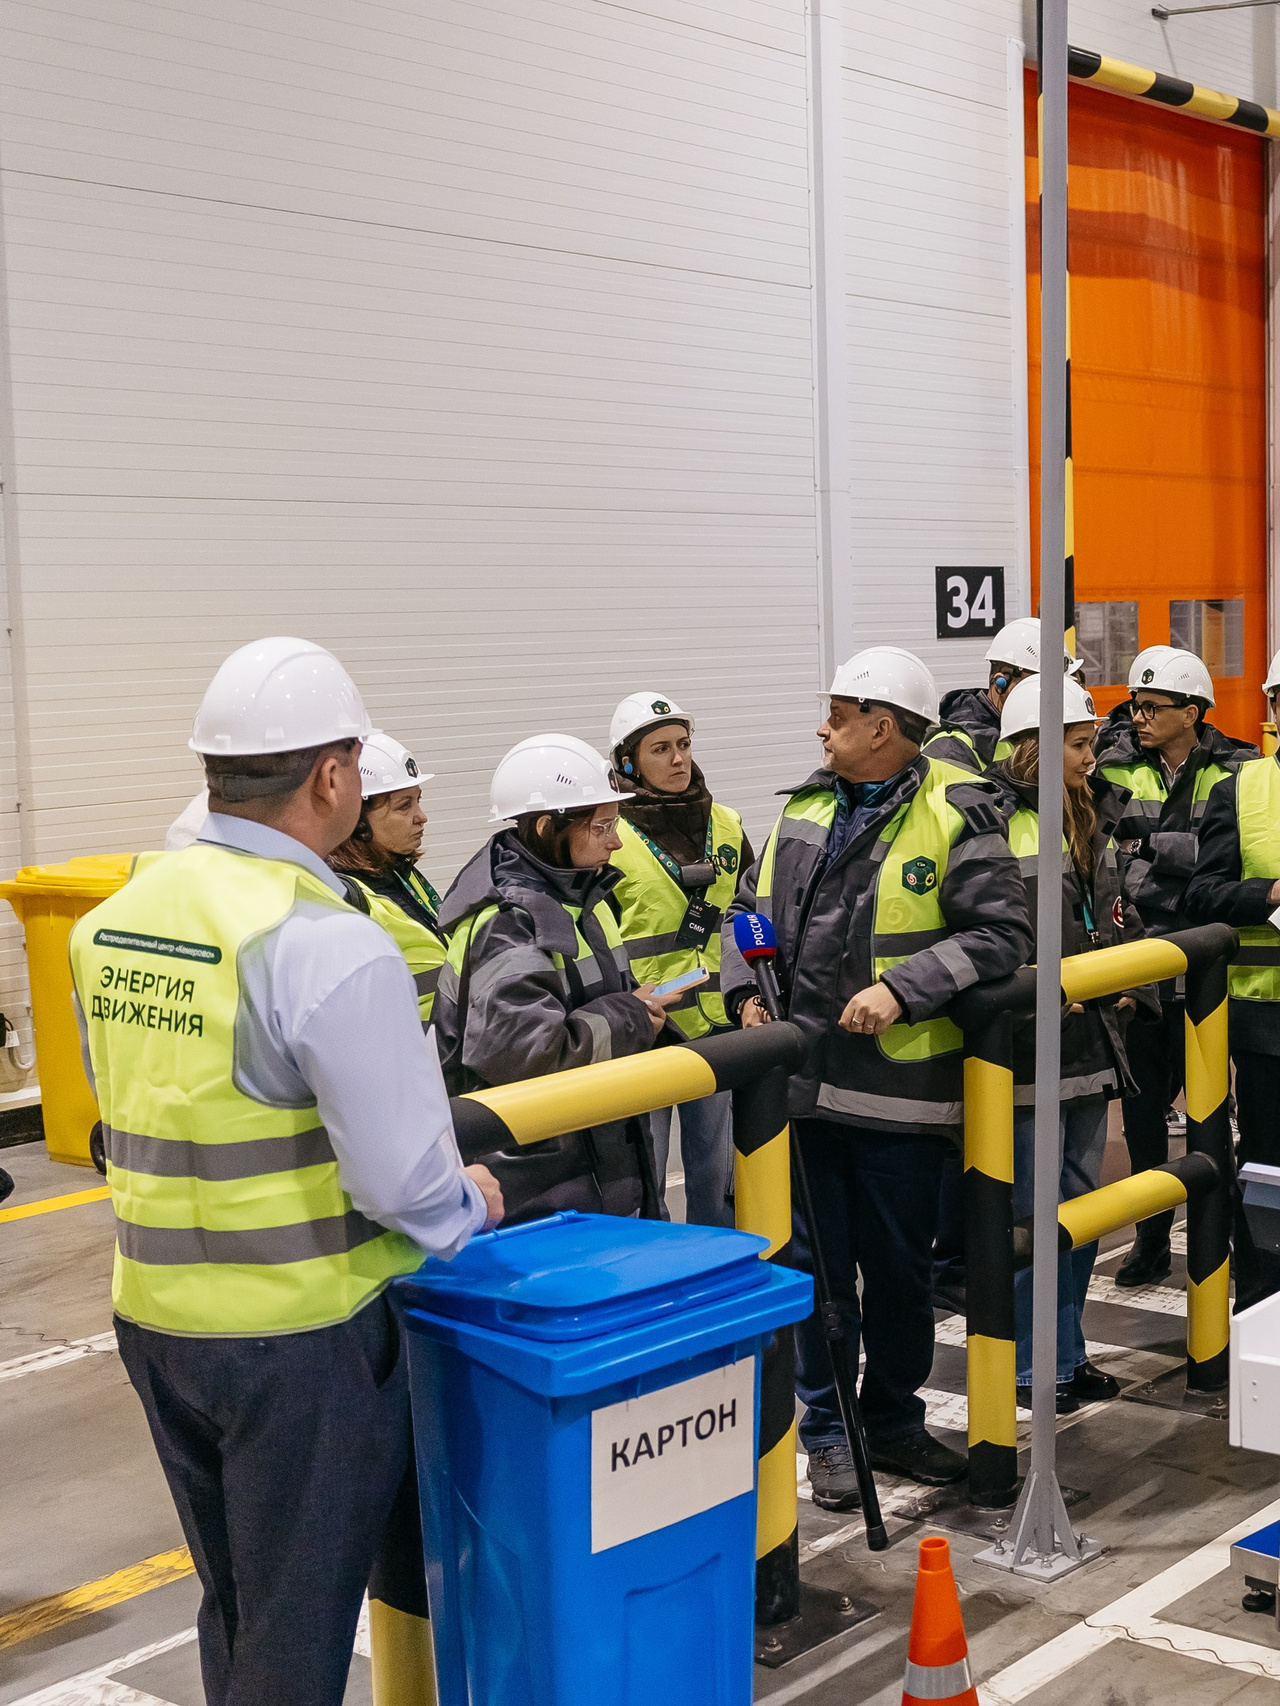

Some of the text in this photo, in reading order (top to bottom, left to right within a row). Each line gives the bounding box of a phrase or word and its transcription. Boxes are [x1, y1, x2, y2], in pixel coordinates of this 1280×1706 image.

[946, 575, 996, 629] 34
[689, 922, 705, 934] СМИ
[746, 914, 766, 946] РОССИЯ
[100, 965, 195, 1003] ЭНЕРГИЯ
[92, 995, 203, 1037] ДВИЖЕНИЯ
[611, 1398, 737, 1472] КАРТОН
